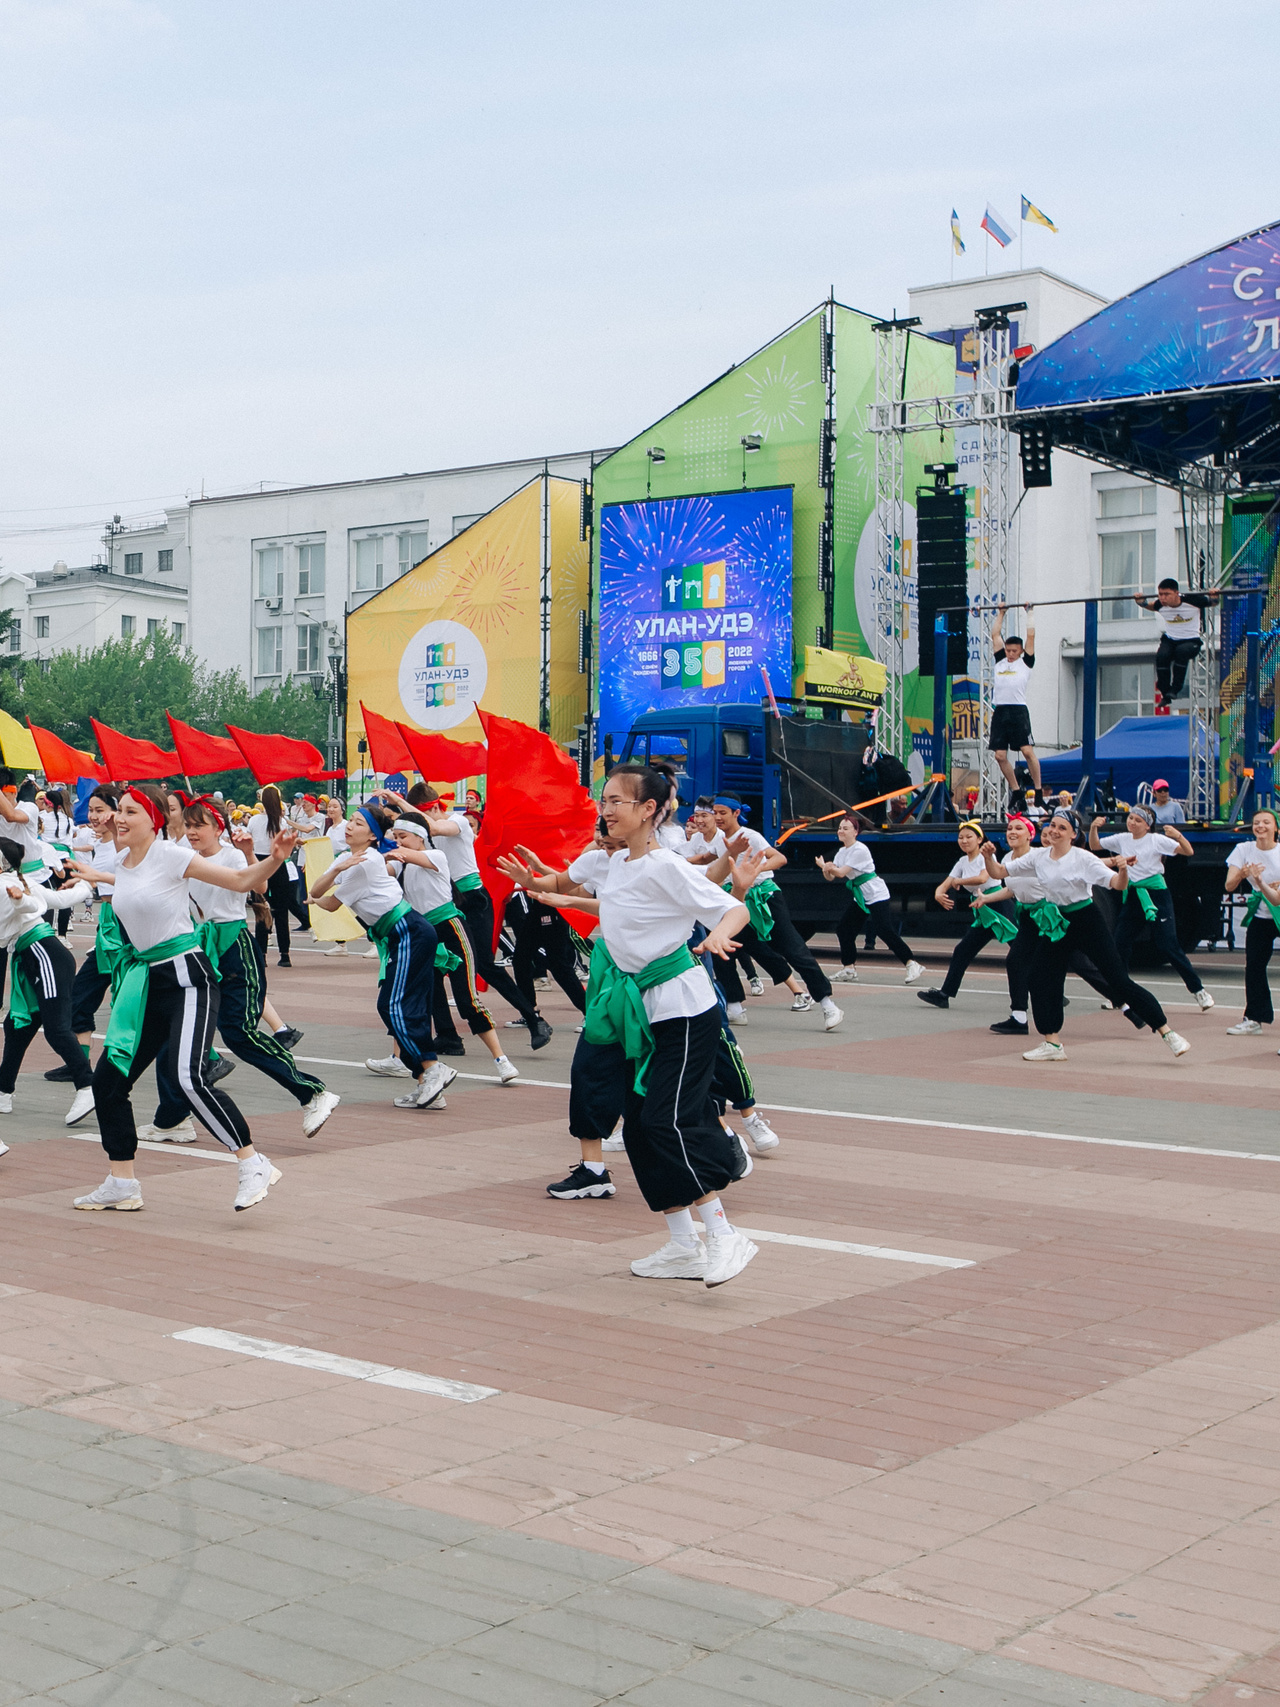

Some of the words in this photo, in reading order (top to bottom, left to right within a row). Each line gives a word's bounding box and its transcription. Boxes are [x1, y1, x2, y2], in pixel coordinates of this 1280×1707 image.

[635, 612, 754, 638] УЛАН-УДЭ
[727, 646, 753, 658] 2022
[663, 646, 724, 677] 356
[415, 669, 469, 681] УЛАН-УДЭ
[817, 684, 861, 698] WORKOUT
[860, 691, 879, 702] ANT
